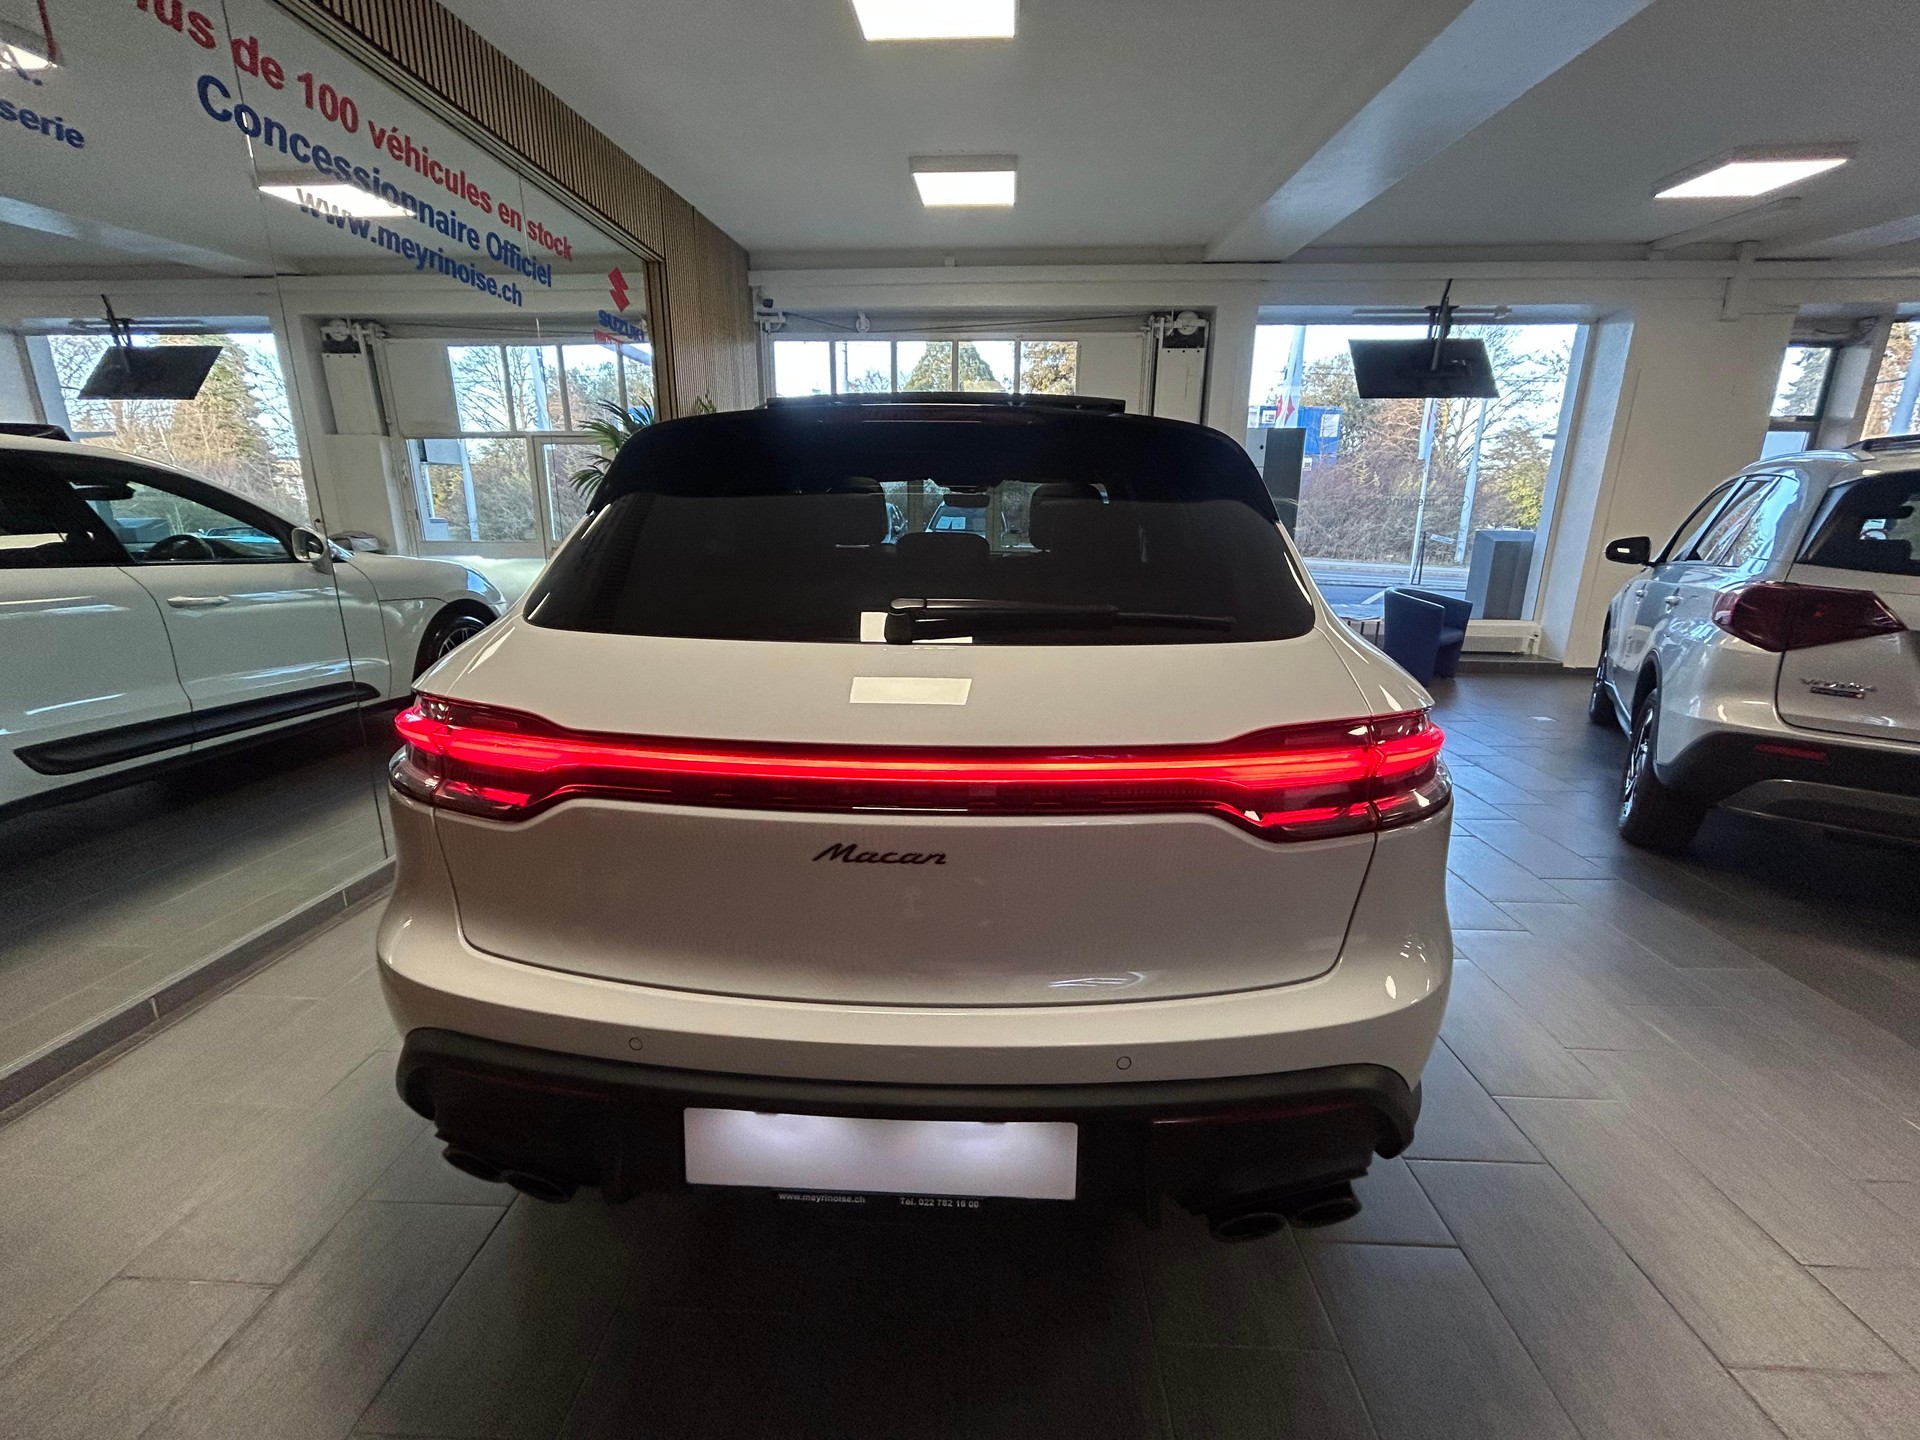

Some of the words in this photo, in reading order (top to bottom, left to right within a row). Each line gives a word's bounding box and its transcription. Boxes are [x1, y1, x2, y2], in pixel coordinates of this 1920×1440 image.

[136, 0, 216, 49] us
[231, 36, 285, 90] de
[298, 72, 359, 133] 100
[368, 120, 492, 214] véhicules
[497, 202, 522, 233] en
[527, 220, 573, 261] stock
[197, 74, 480, 250] Concessionnaire
[486, 231, 552, 288] Officiel
[296, 187, 523, 307] www.meyrinoise.ch
[812, 842, 947, 865] Macan
[778, 1193, 866, 1203] www.meyrinoise.ch
[918, 1198, 934, 1207] 022
[937, 1199, 953, 1208] 782
[956, 1200, 966, 1208] 16
[968, 1200, 980, 1209] 00
